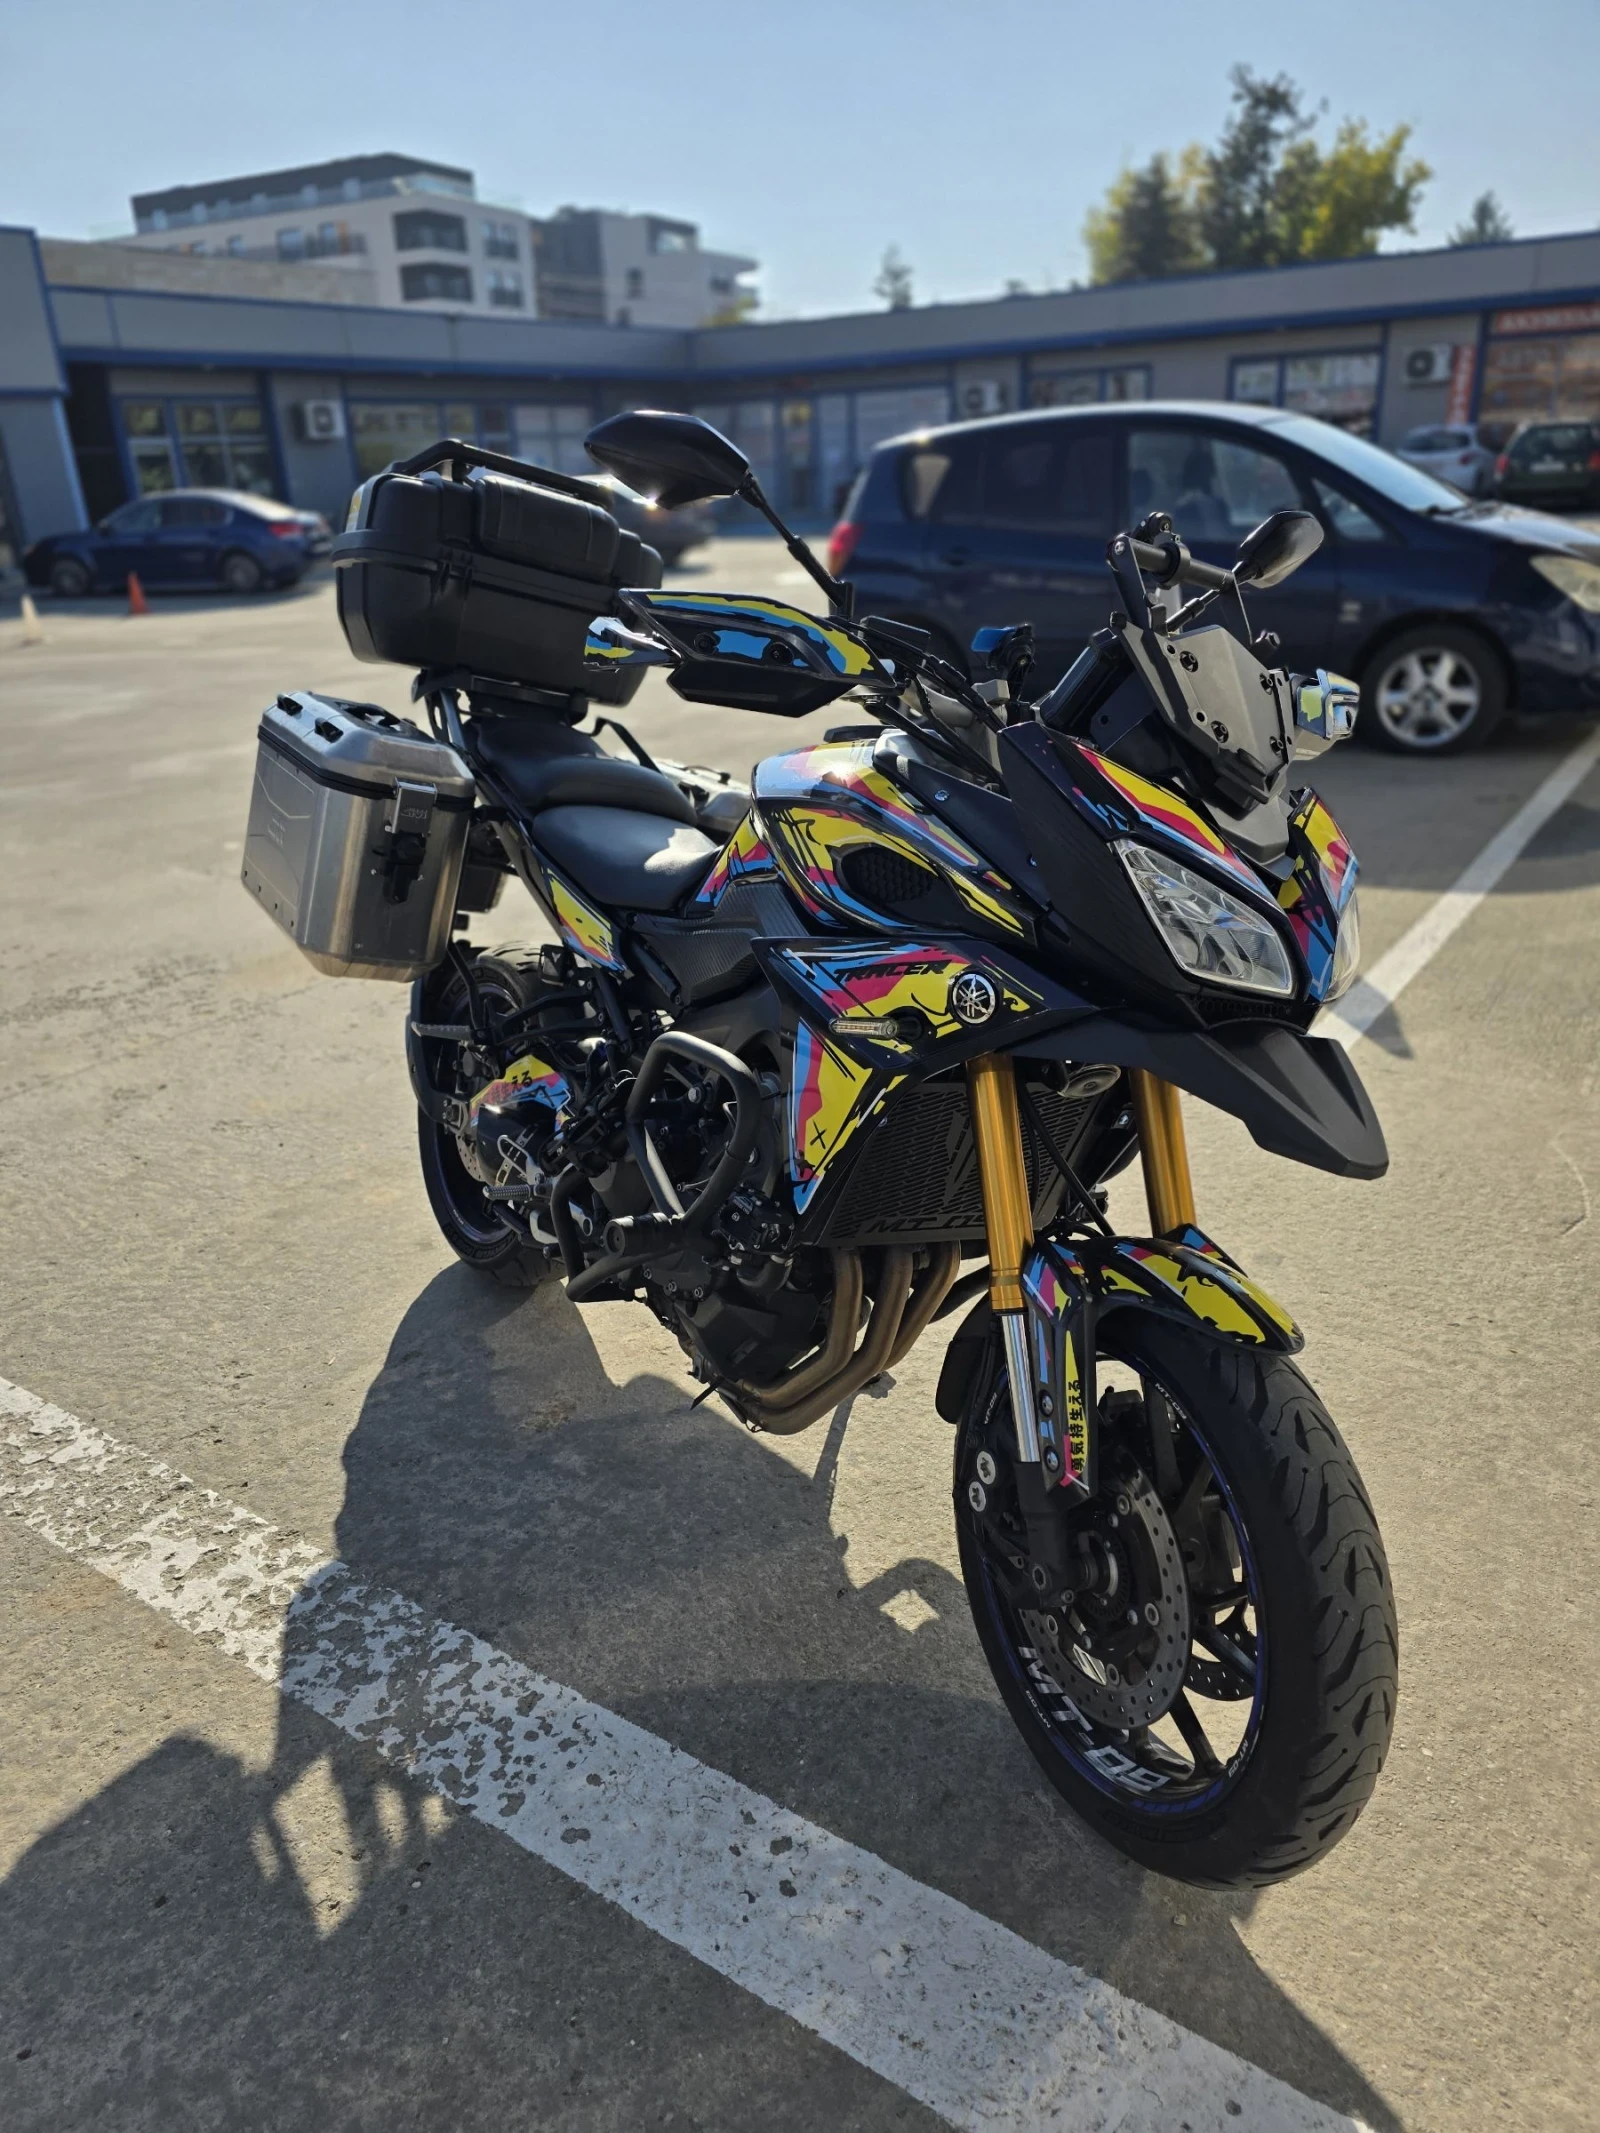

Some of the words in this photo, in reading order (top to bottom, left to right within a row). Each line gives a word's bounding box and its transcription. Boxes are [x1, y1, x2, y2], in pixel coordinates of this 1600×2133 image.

[834, 959, 953, 983] TRACER
[865, 1216, 938, 1234] MT
[1155, 1383, 1187, 1419] MT-09
[1018, 1646, 1171, 1792] MT-09
[1025, 1690, 1051, 1728] MT-09
[1228, 1739, 1249, 1778] MT-09
